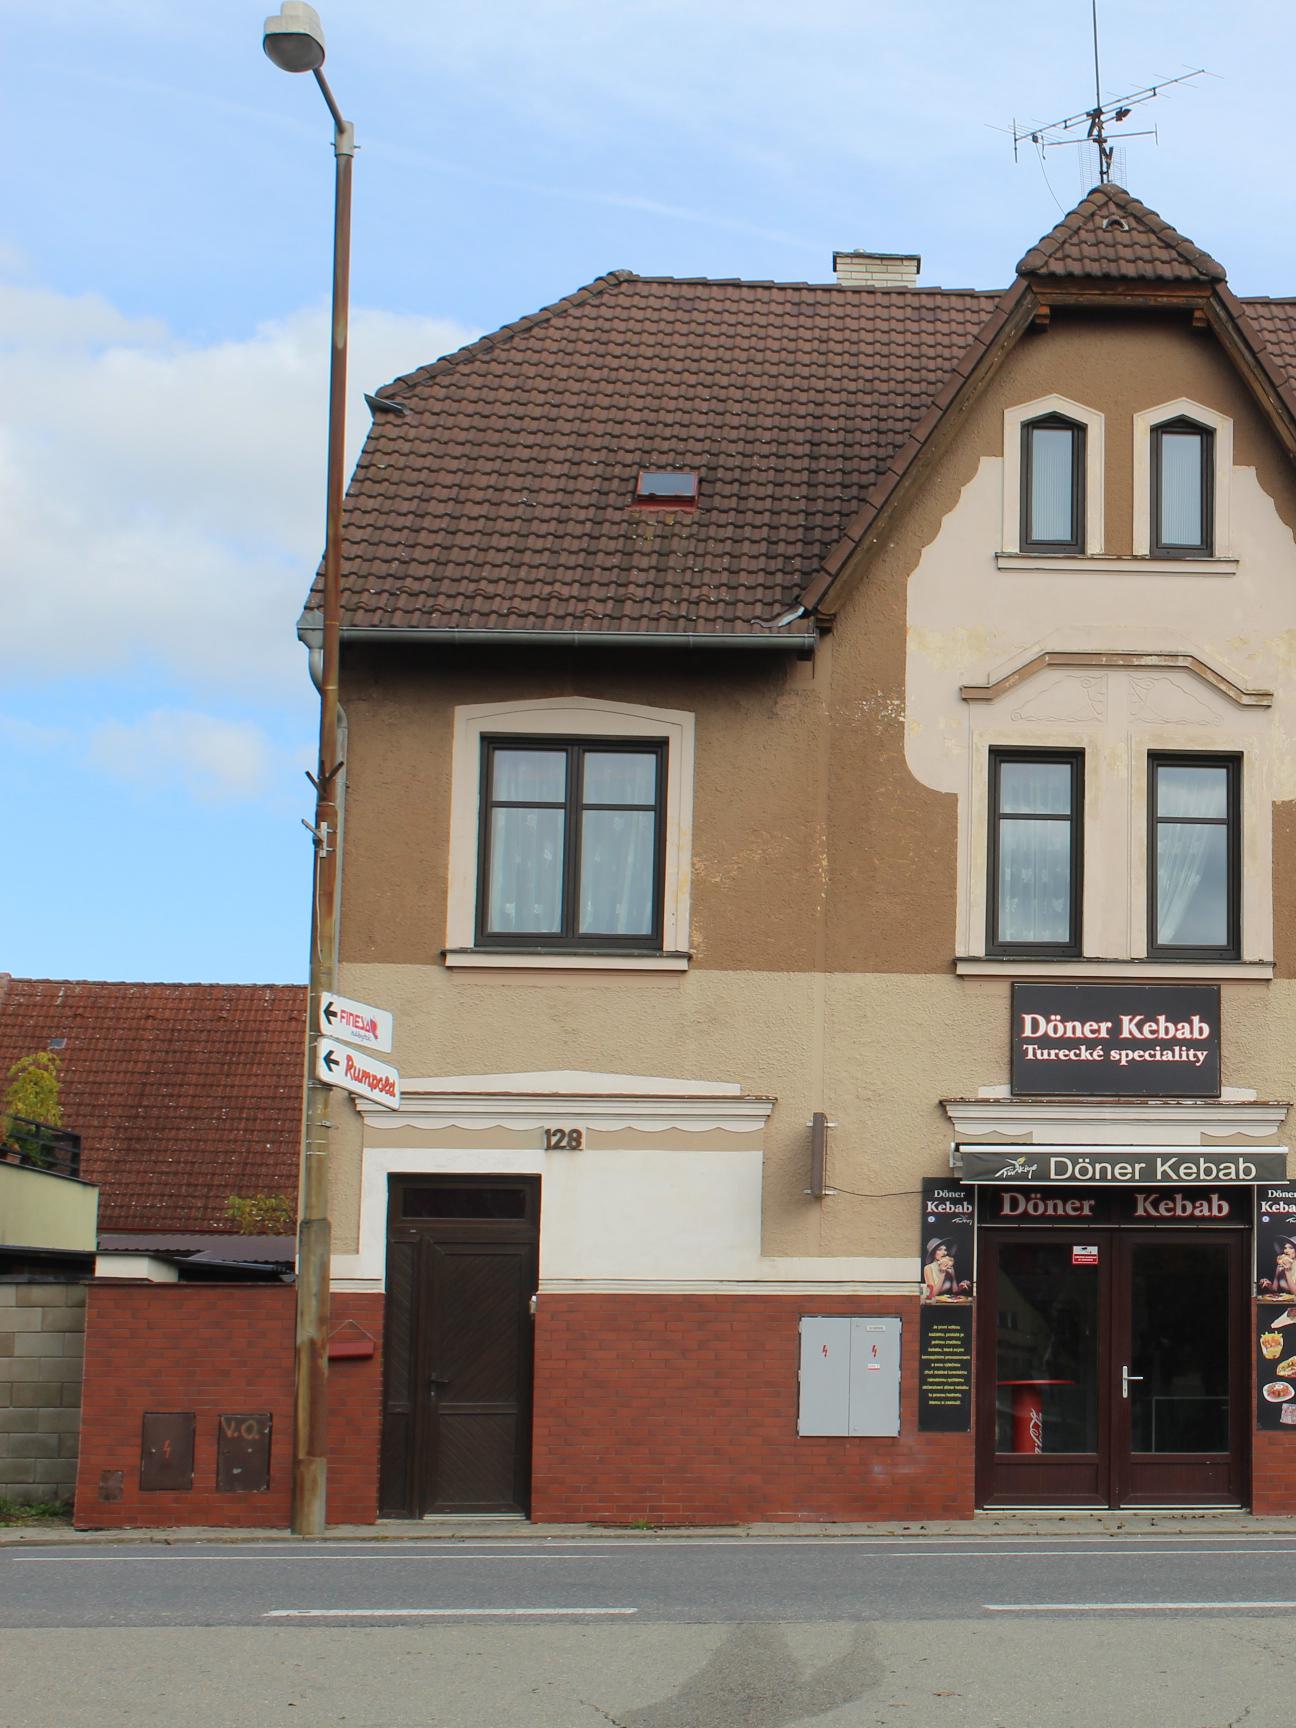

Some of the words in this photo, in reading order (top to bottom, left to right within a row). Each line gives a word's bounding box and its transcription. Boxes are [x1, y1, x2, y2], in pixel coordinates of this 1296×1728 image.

[1021, 1013, 1112, 1039] Döner
[1119, 1014, 1210, 1040] Kebab
[1022, 1044, 1104, 1061] Turecké
[1109, 1045, 1209, 1067] speciality
[344, 1054, 397, 1098] Rumpold
[544, 1128, 583, 1150] 128
[1050, 1157, 1146, 1180] Döner
[1156, 1157, 1257, 1180] Kebab
[934, 1189, 966, 1198] Döner
[1000, 1192, 1096, 1217] Döner
[1134, 1193, 1230, 1218] Kebab
[926, 1201, 973, 1213] Kebab
